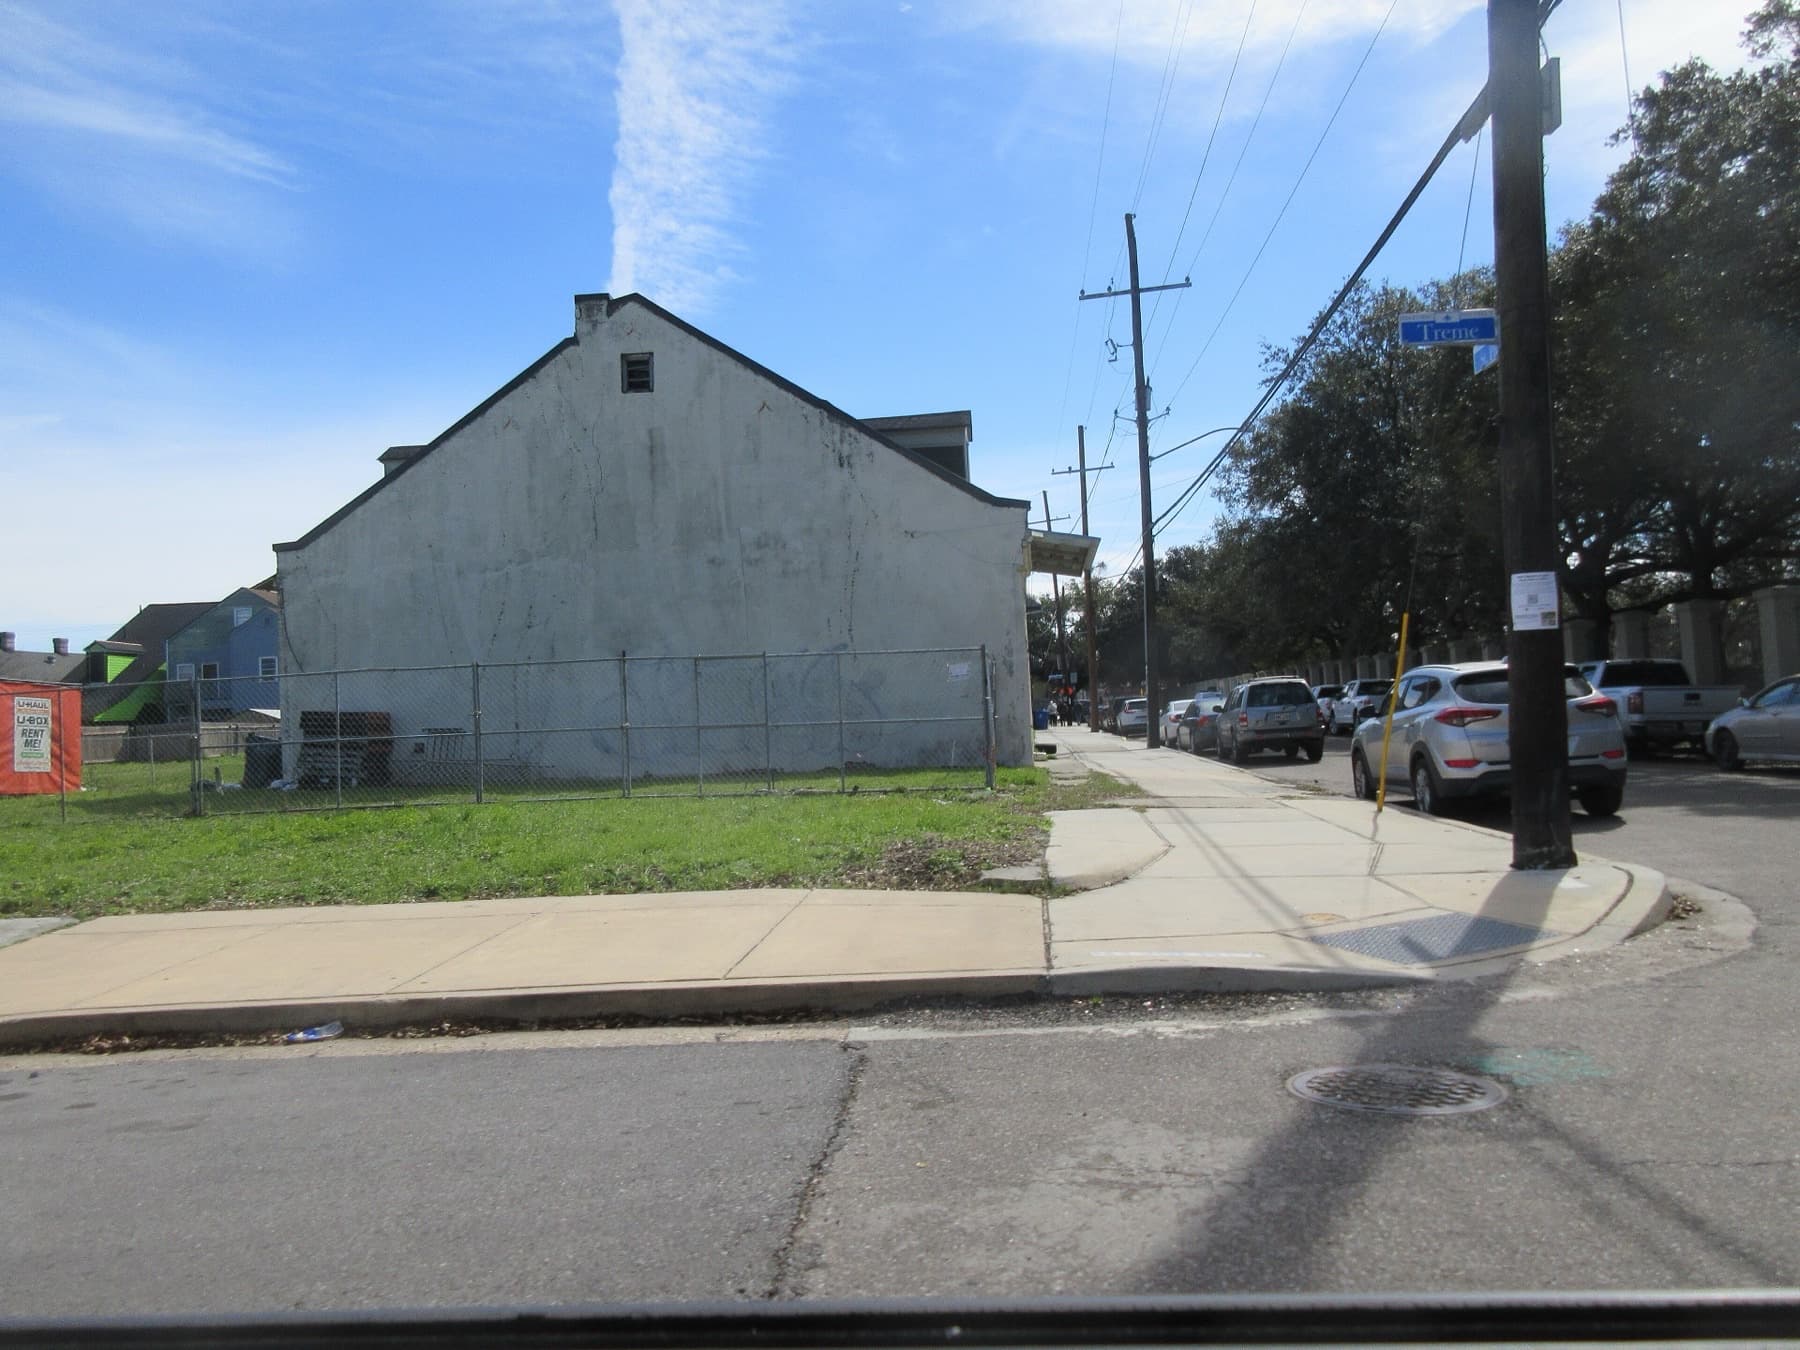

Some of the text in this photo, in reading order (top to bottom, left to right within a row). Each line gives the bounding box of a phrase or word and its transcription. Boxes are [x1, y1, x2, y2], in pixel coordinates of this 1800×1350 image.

[1417, 323, 1479, 341] Treme
[17, 716, 48, 725] U-BOX
[21, 729, 45, 738] RENT
[24, 739, 41, 748] ME!
